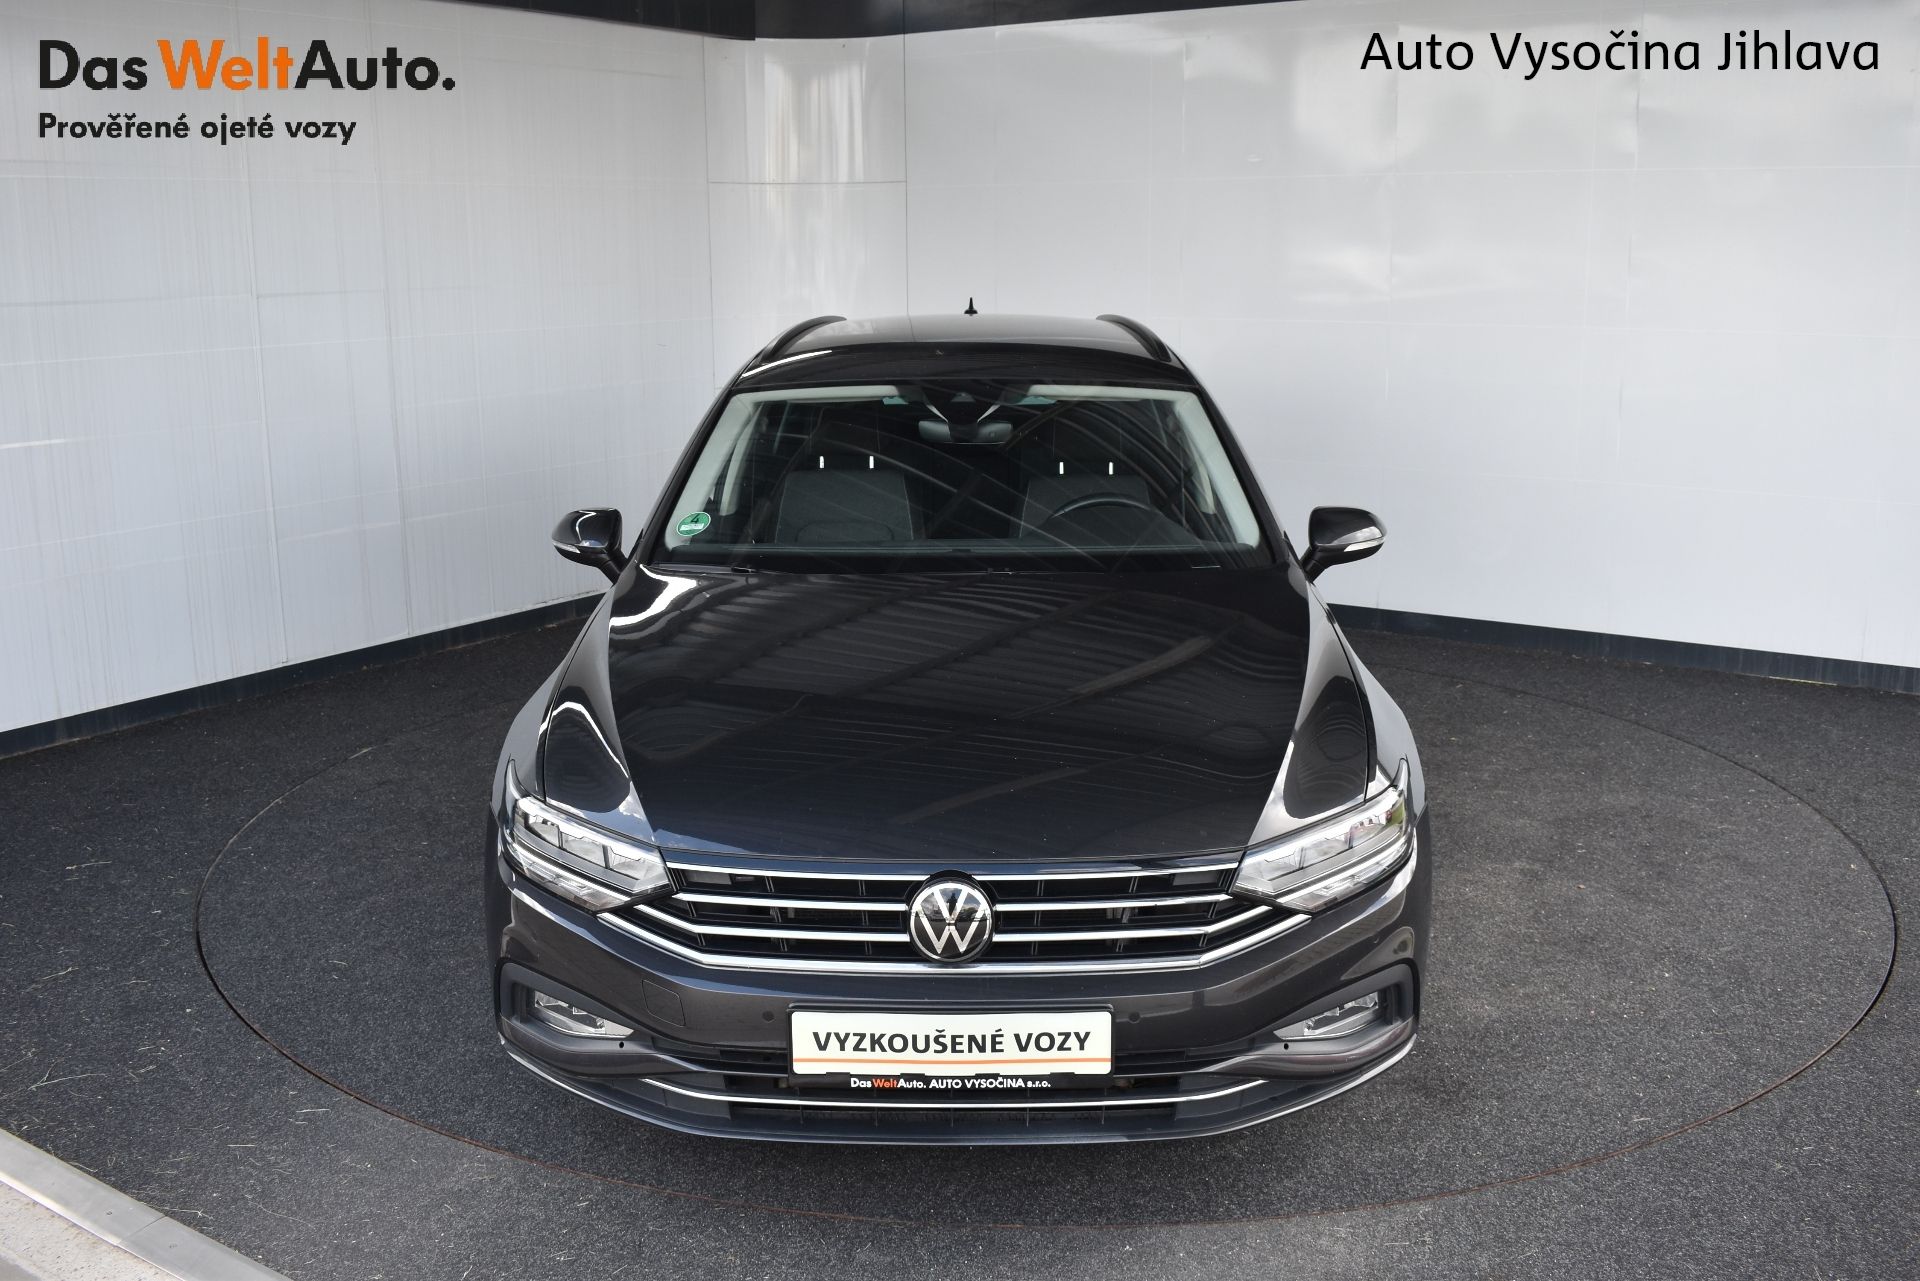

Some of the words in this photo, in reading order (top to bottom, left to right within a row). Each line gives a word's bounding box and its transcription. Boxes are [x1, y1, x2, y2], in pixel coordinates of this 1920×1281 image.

[812, 1028, 1005, 1054] VYZKOUŠENÉ
[1013, 1031, 1091, 1053] VOZY
[850, 1077, 872, 1088] Das
[873, 1078, 927, 1089] WeltAuto.
[929, 1078, 962, 1089] AUTO
[964, 1076, 1026, 1089] VYSOČINA
[1026, 1080, 1051, 1088] s.r.o.
